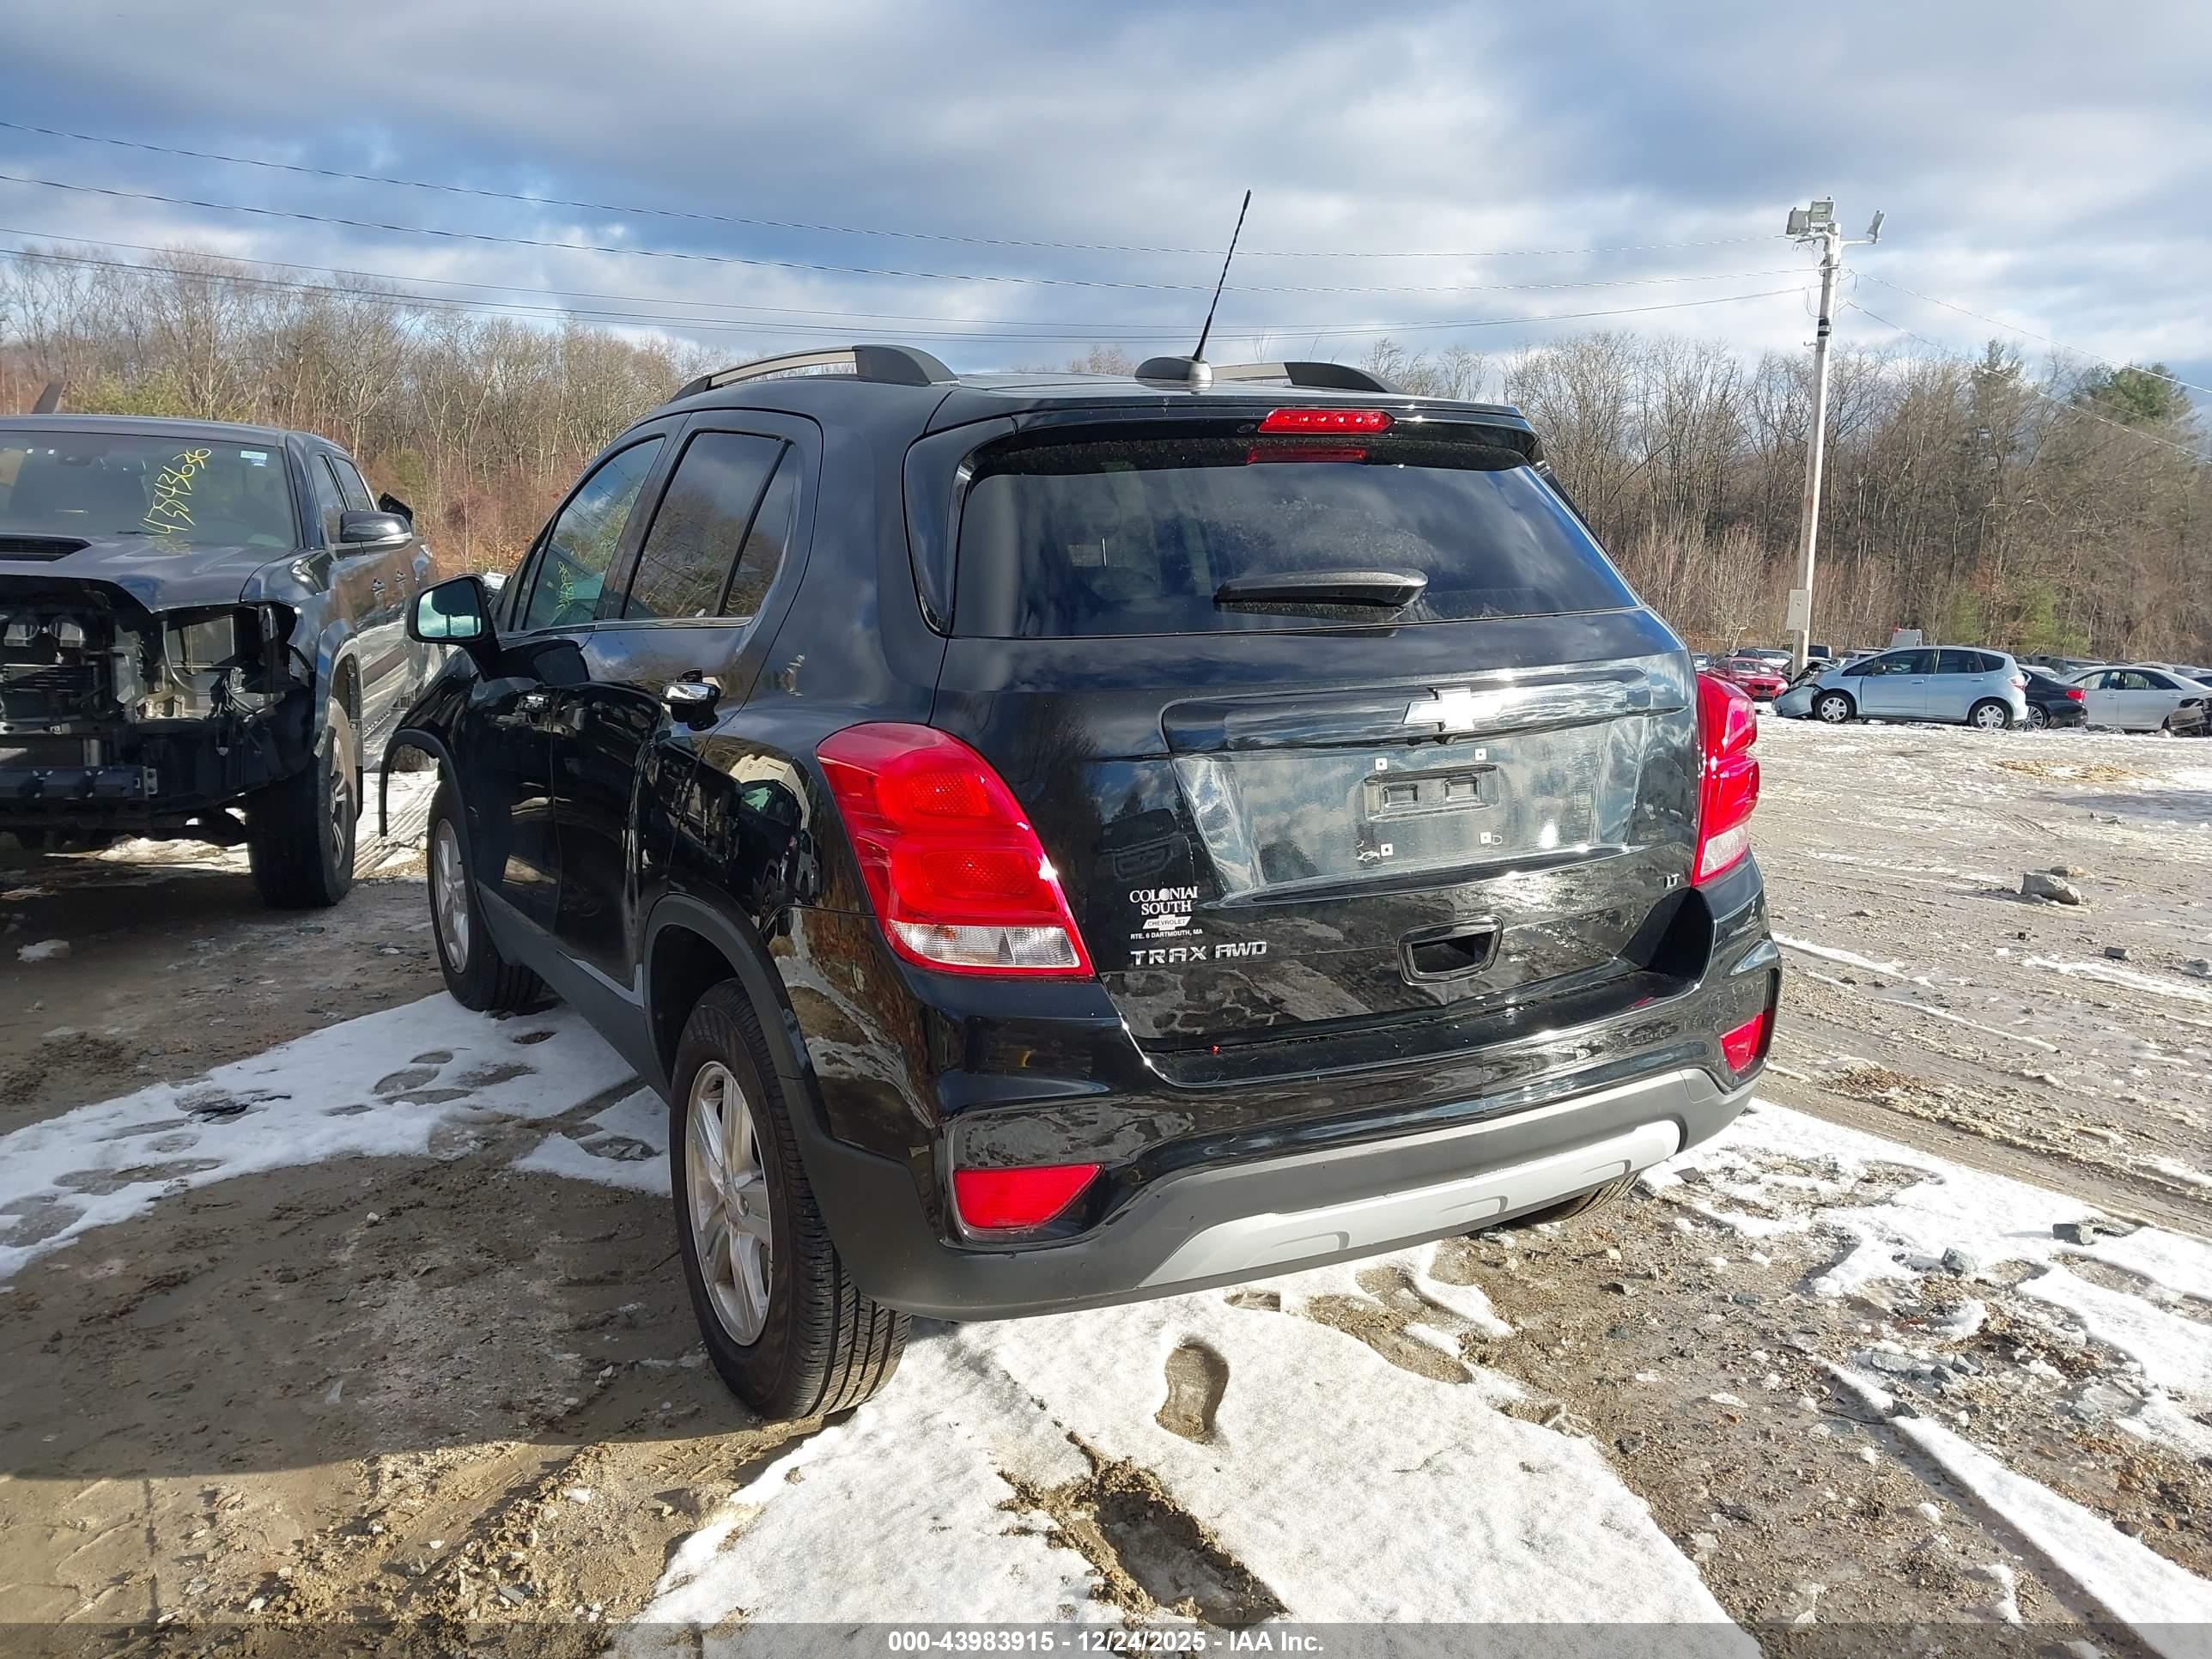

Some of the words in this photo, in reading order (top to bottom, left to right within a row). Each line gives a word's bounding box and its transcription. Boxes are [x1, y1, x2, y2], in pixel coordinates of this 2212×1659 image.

[1664, 873, 1680, 889] LT
[1141, 900, 1193, 915] SOUTH
[1147, 918, 1187, 927] CHEVROLET
[1130, 946, 1207, 965] TRAX
[1215, 941, 1267, 959] AWD
